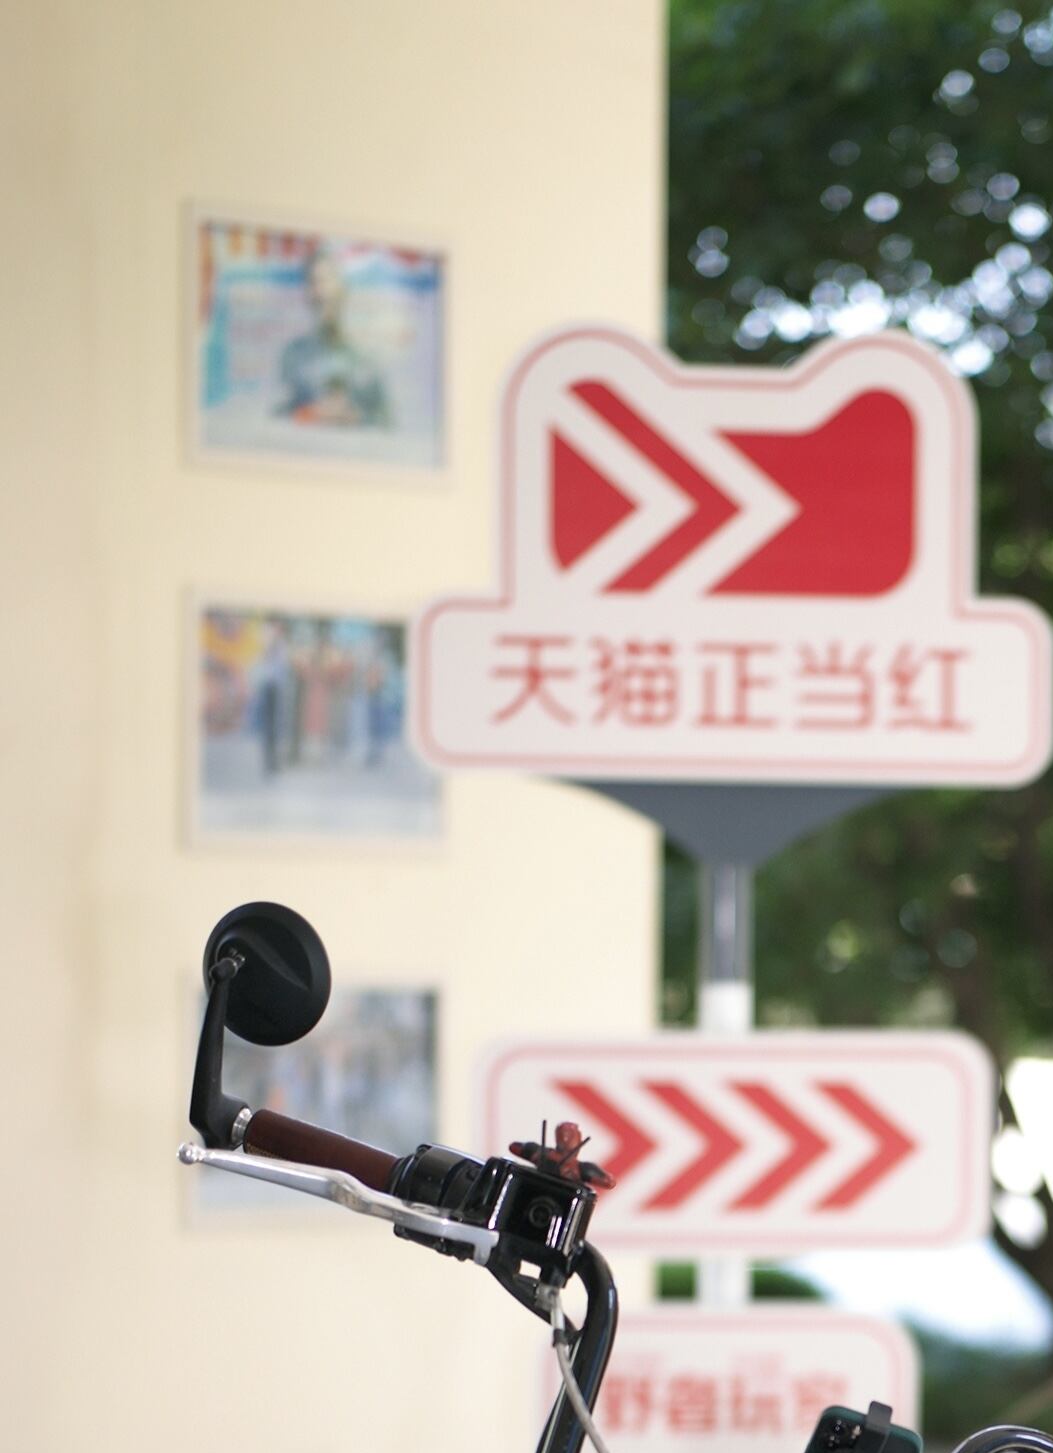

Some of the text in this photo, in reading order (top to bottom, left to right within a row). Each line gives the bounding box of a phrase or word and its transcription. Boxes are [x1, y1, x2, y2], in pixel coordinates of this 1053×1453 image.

[489, 634, 973, 733] 天猫正当红
